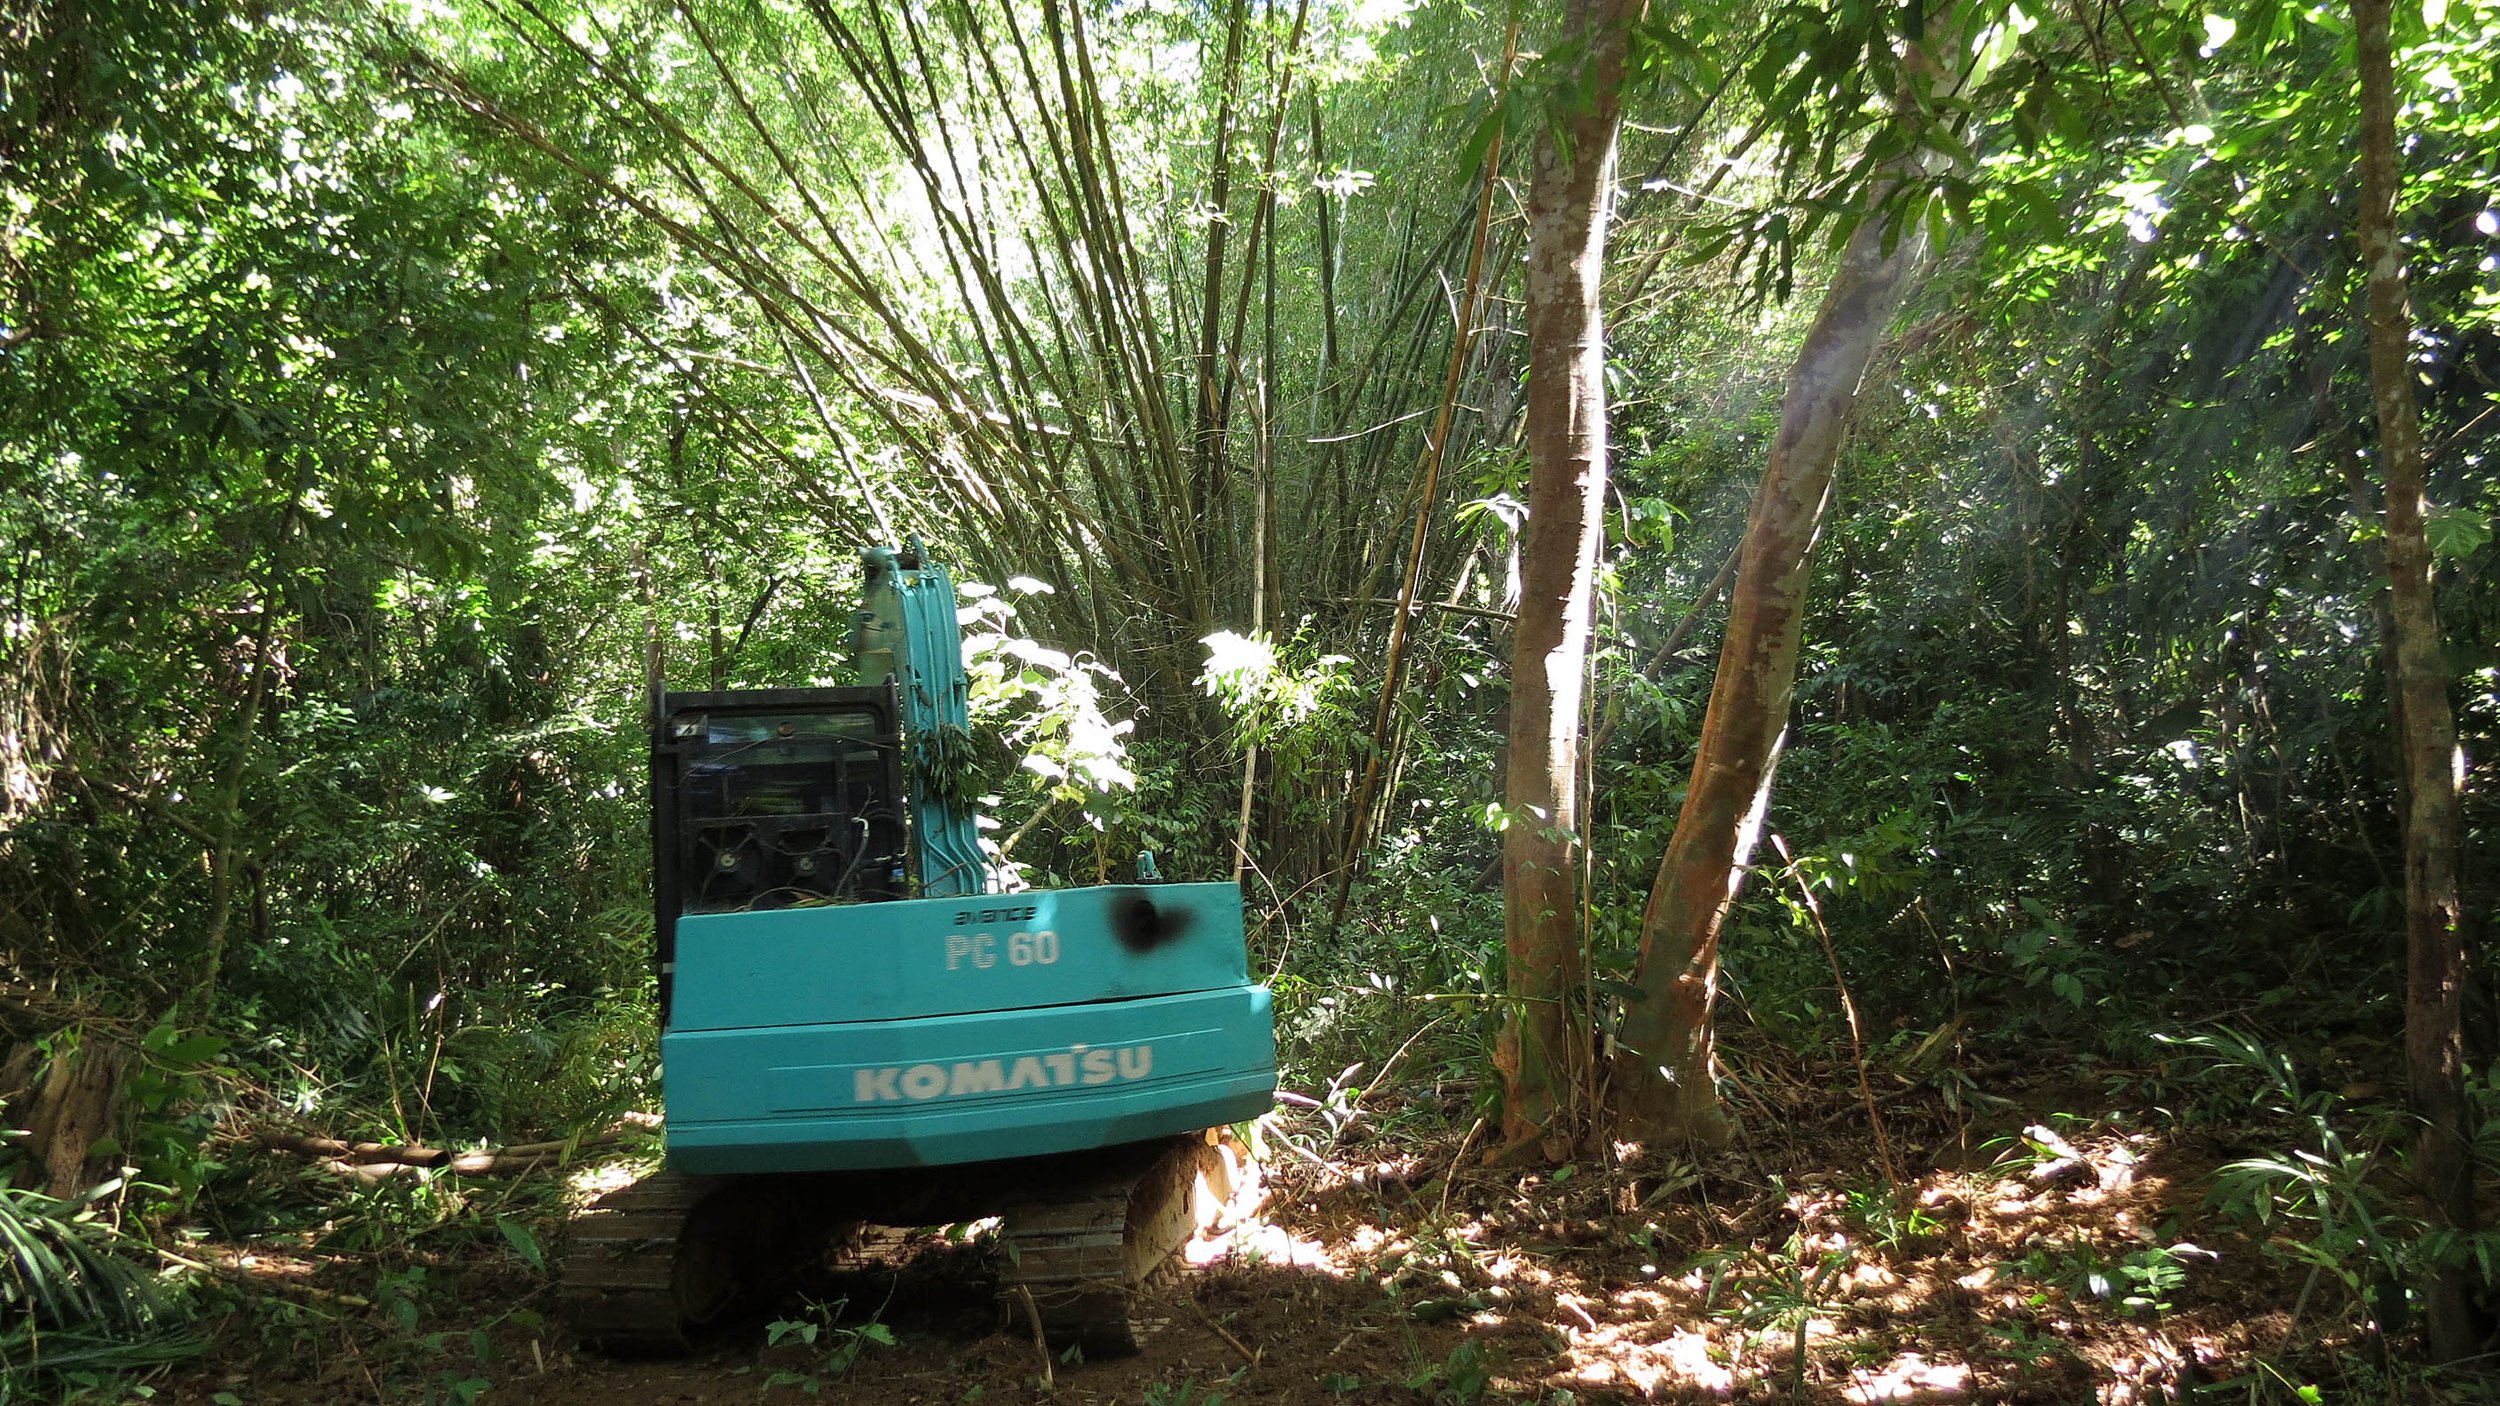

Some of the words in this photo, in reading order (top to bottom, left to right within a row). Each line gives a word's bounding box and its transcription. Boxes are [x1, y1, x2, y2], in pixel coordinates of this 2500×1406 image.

[945, 933, 997, 971] PC
[1008, 930, 1061, 966] 60
[855, 1043, 1153, 1101] KOMATSU
